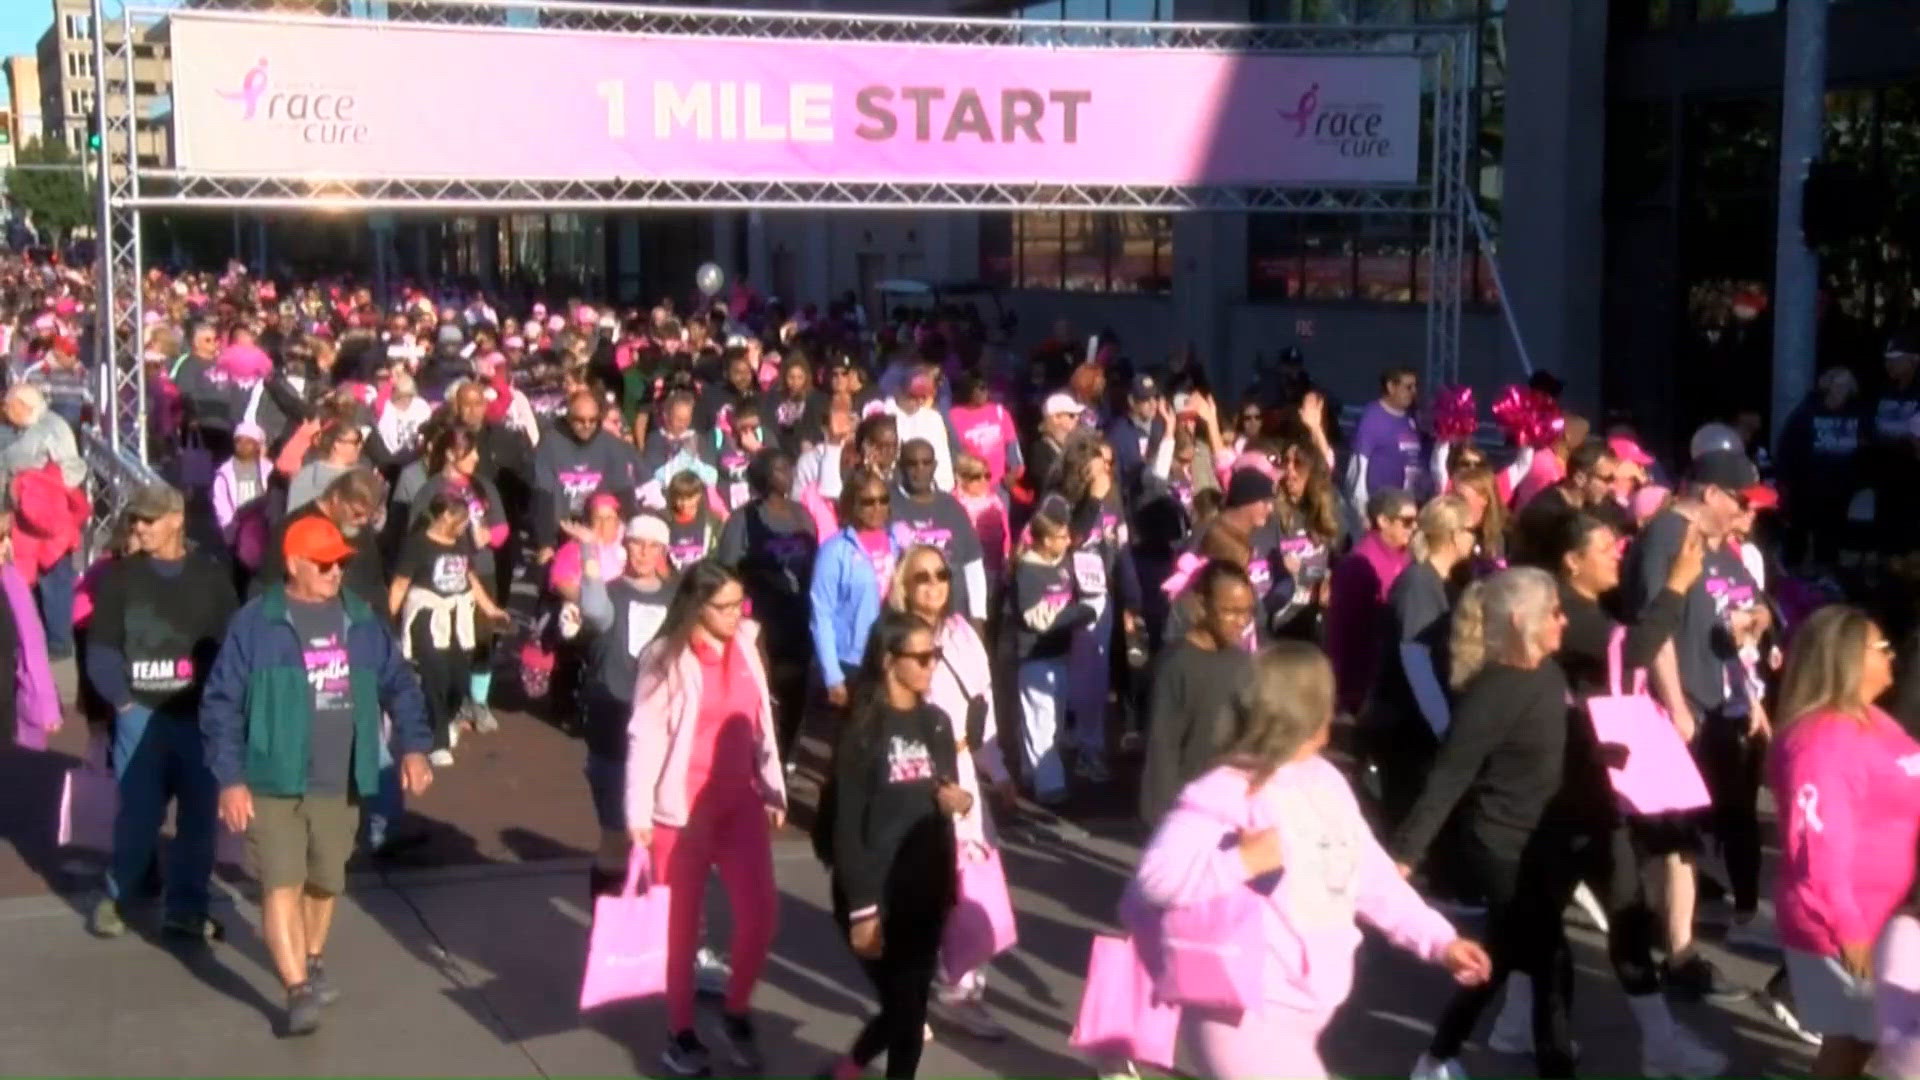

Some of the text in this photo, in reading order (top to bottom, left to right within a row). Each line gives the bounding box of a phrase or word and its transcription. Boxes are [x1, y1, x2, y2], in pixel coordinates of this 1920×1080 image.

[268, 93, 355, 121] race
[598, 79, 1093, 144] 1 MILE START
[303, 122, 369, 145] cure
[1315, 111, 1382, 137] race
[1339, 137, 1391, 158] cure
[132, 659, 175, 679] TEAM
